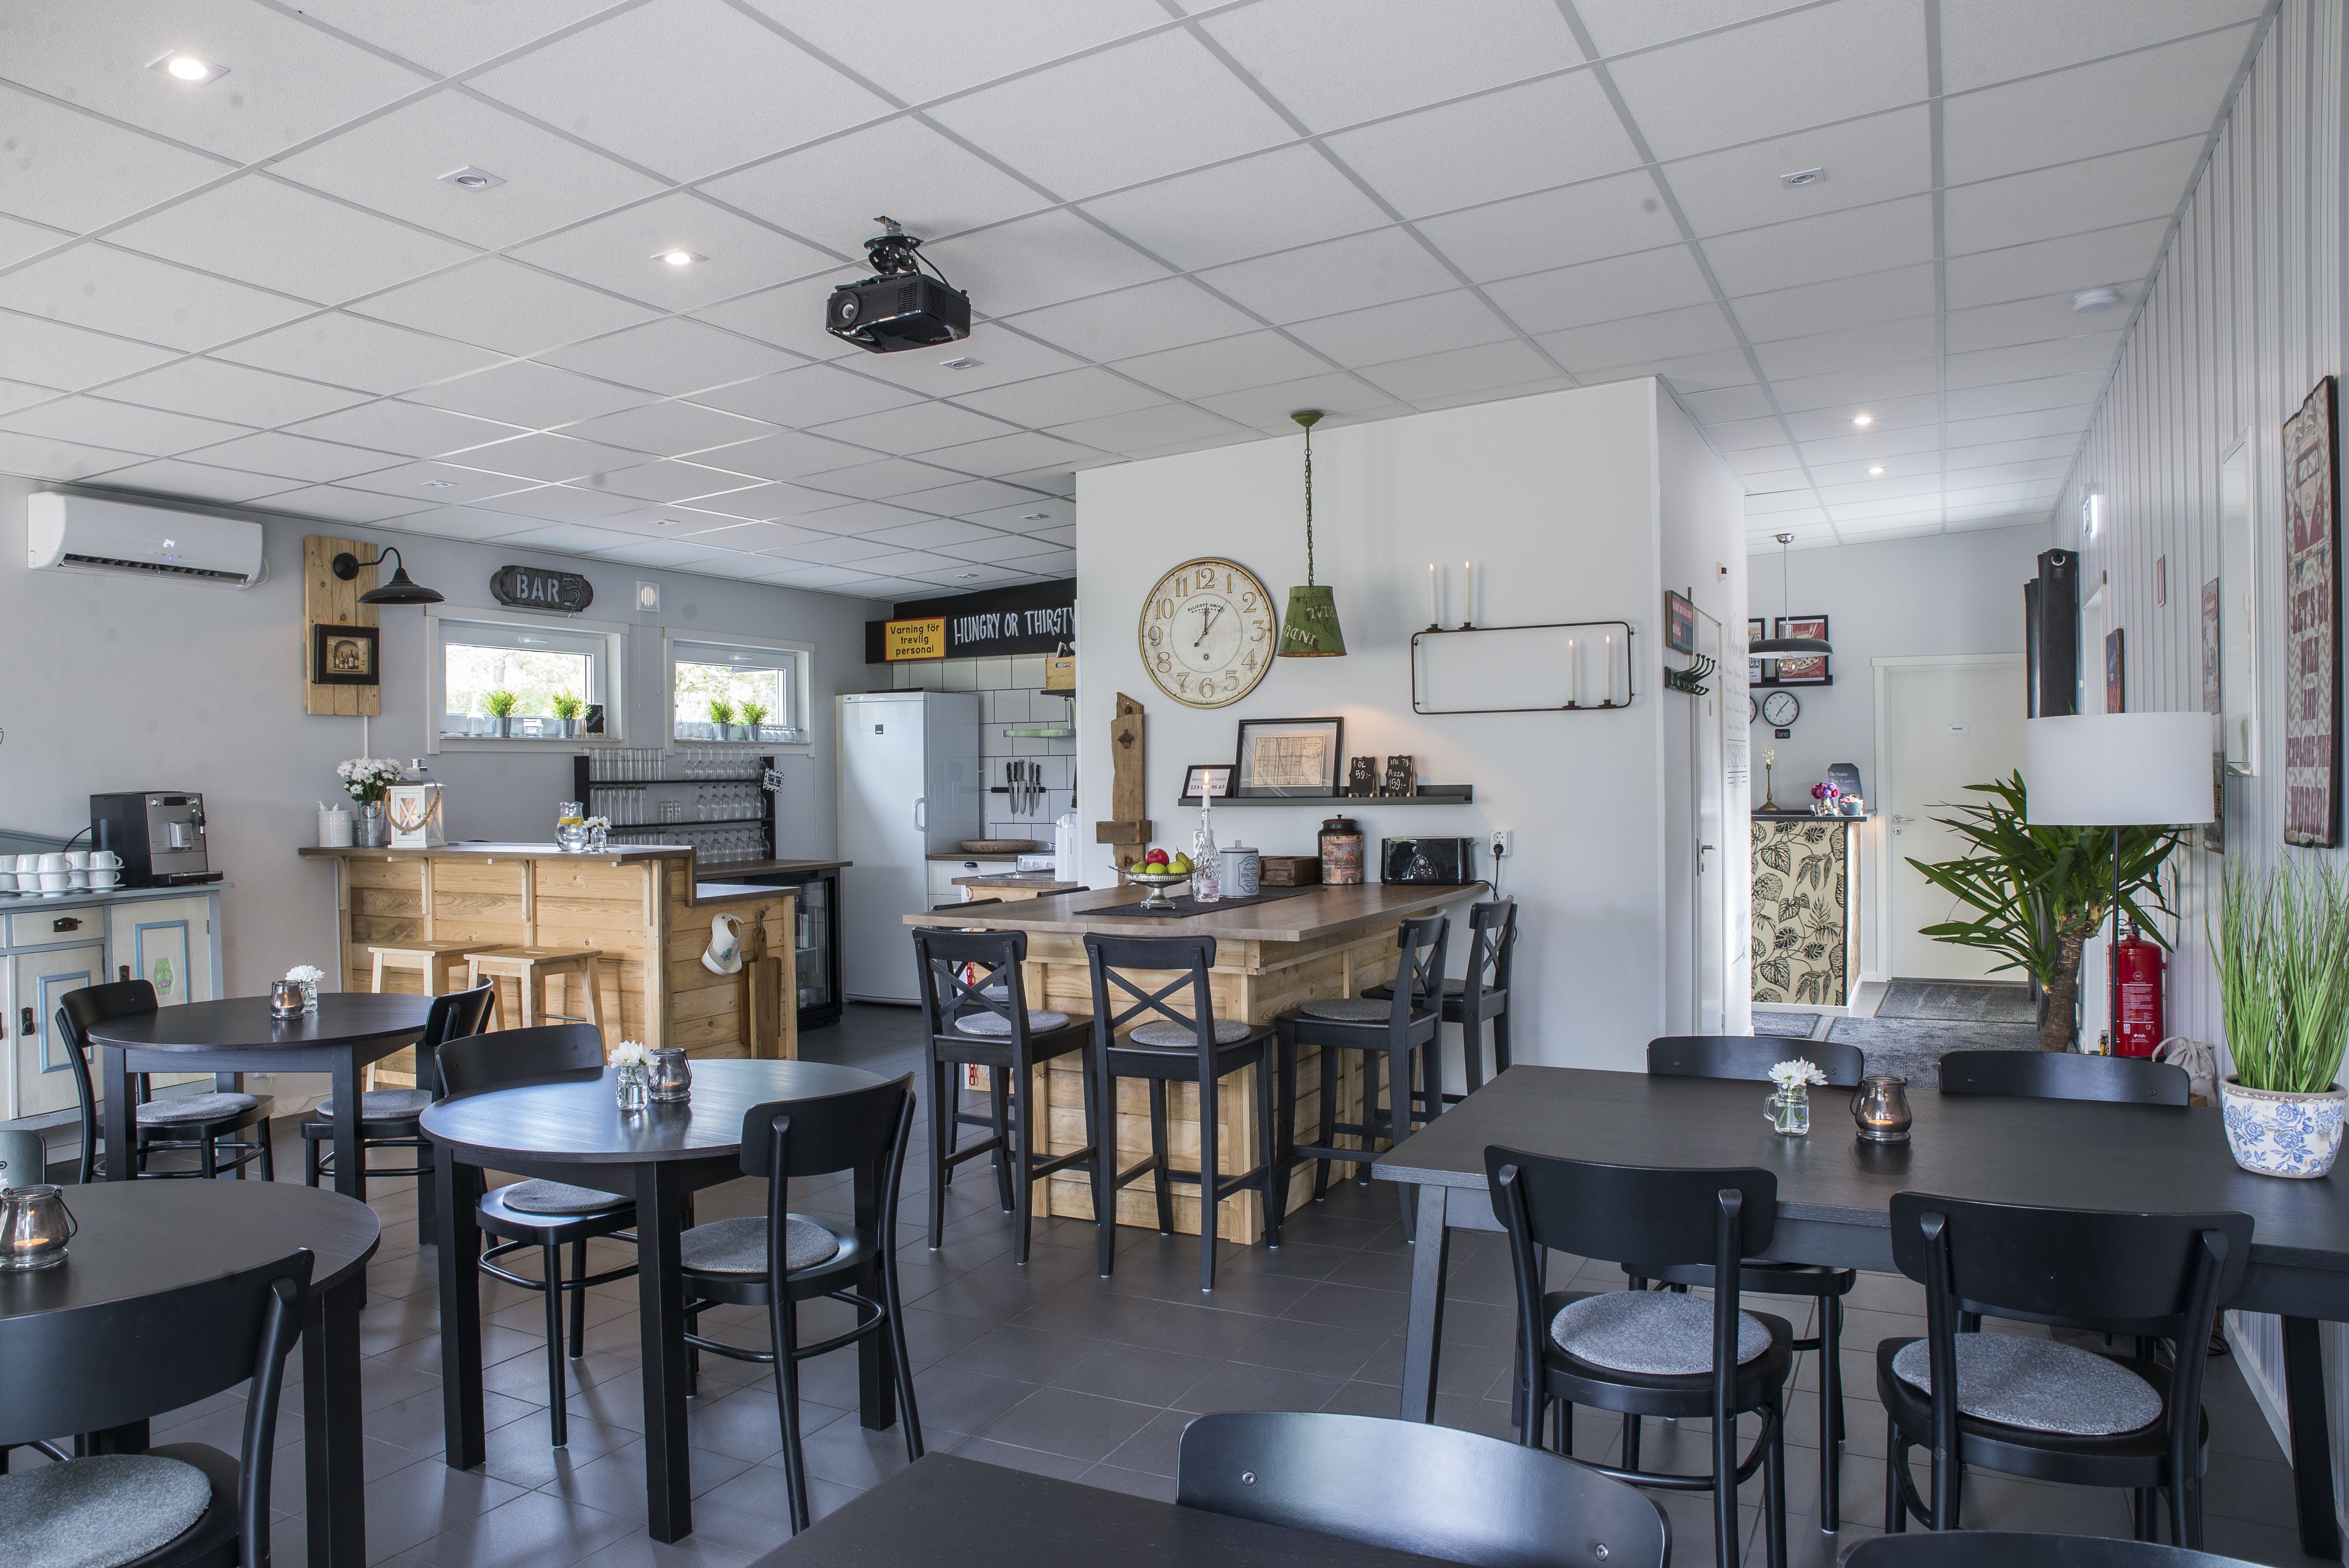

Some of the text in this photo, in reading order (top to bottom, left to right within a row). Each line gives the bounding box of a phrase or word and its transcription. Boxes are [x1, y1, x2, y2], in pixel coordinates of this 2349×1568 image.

[163, 539, 175, 548] 24
[516, 574, 560, 603] BAR
[1175, 576, 1189, 597] 11
[1195, 568, 1215, 590] 12
[1226, 573, 1233, 593] 1
[1156, 598, 1174, 620] 10
[1187, 603, 1208, 612] ELLICOTT
[1242, 592, 1257, 613] 2
[2292, 579, 2329, 634] LET'S GO
[890, 623, 940, 635] Varning för
[954, 612, 1000, 646] HUNGRY
[1004, 612, 1019, 637] OR
[1148, 626, 1163, 646] 9
[1250, 620, 1266, 641] 3
[900, 635, 929, 645] trevlig
[896, 645, 934, 657] personal
[1241, 648, 1258, 669] 4
[2301, 636, 2318, 676] WILD
[1156, 652, 1172, 673] 8
[1177, 672, 1190, 693] 7
[1199, 678, 1215, 699] 6
[1224, 671, 1239, 691] 5
[2303, 688, 2316, 721] AND
[2287, 735, 2330, 767] EXPLORE THE
[1358, 758, 1366, 768] ÖL
[1388, 779, 1406, 790] 159:-
[2291, 787, 2326, 837] WORLD!
